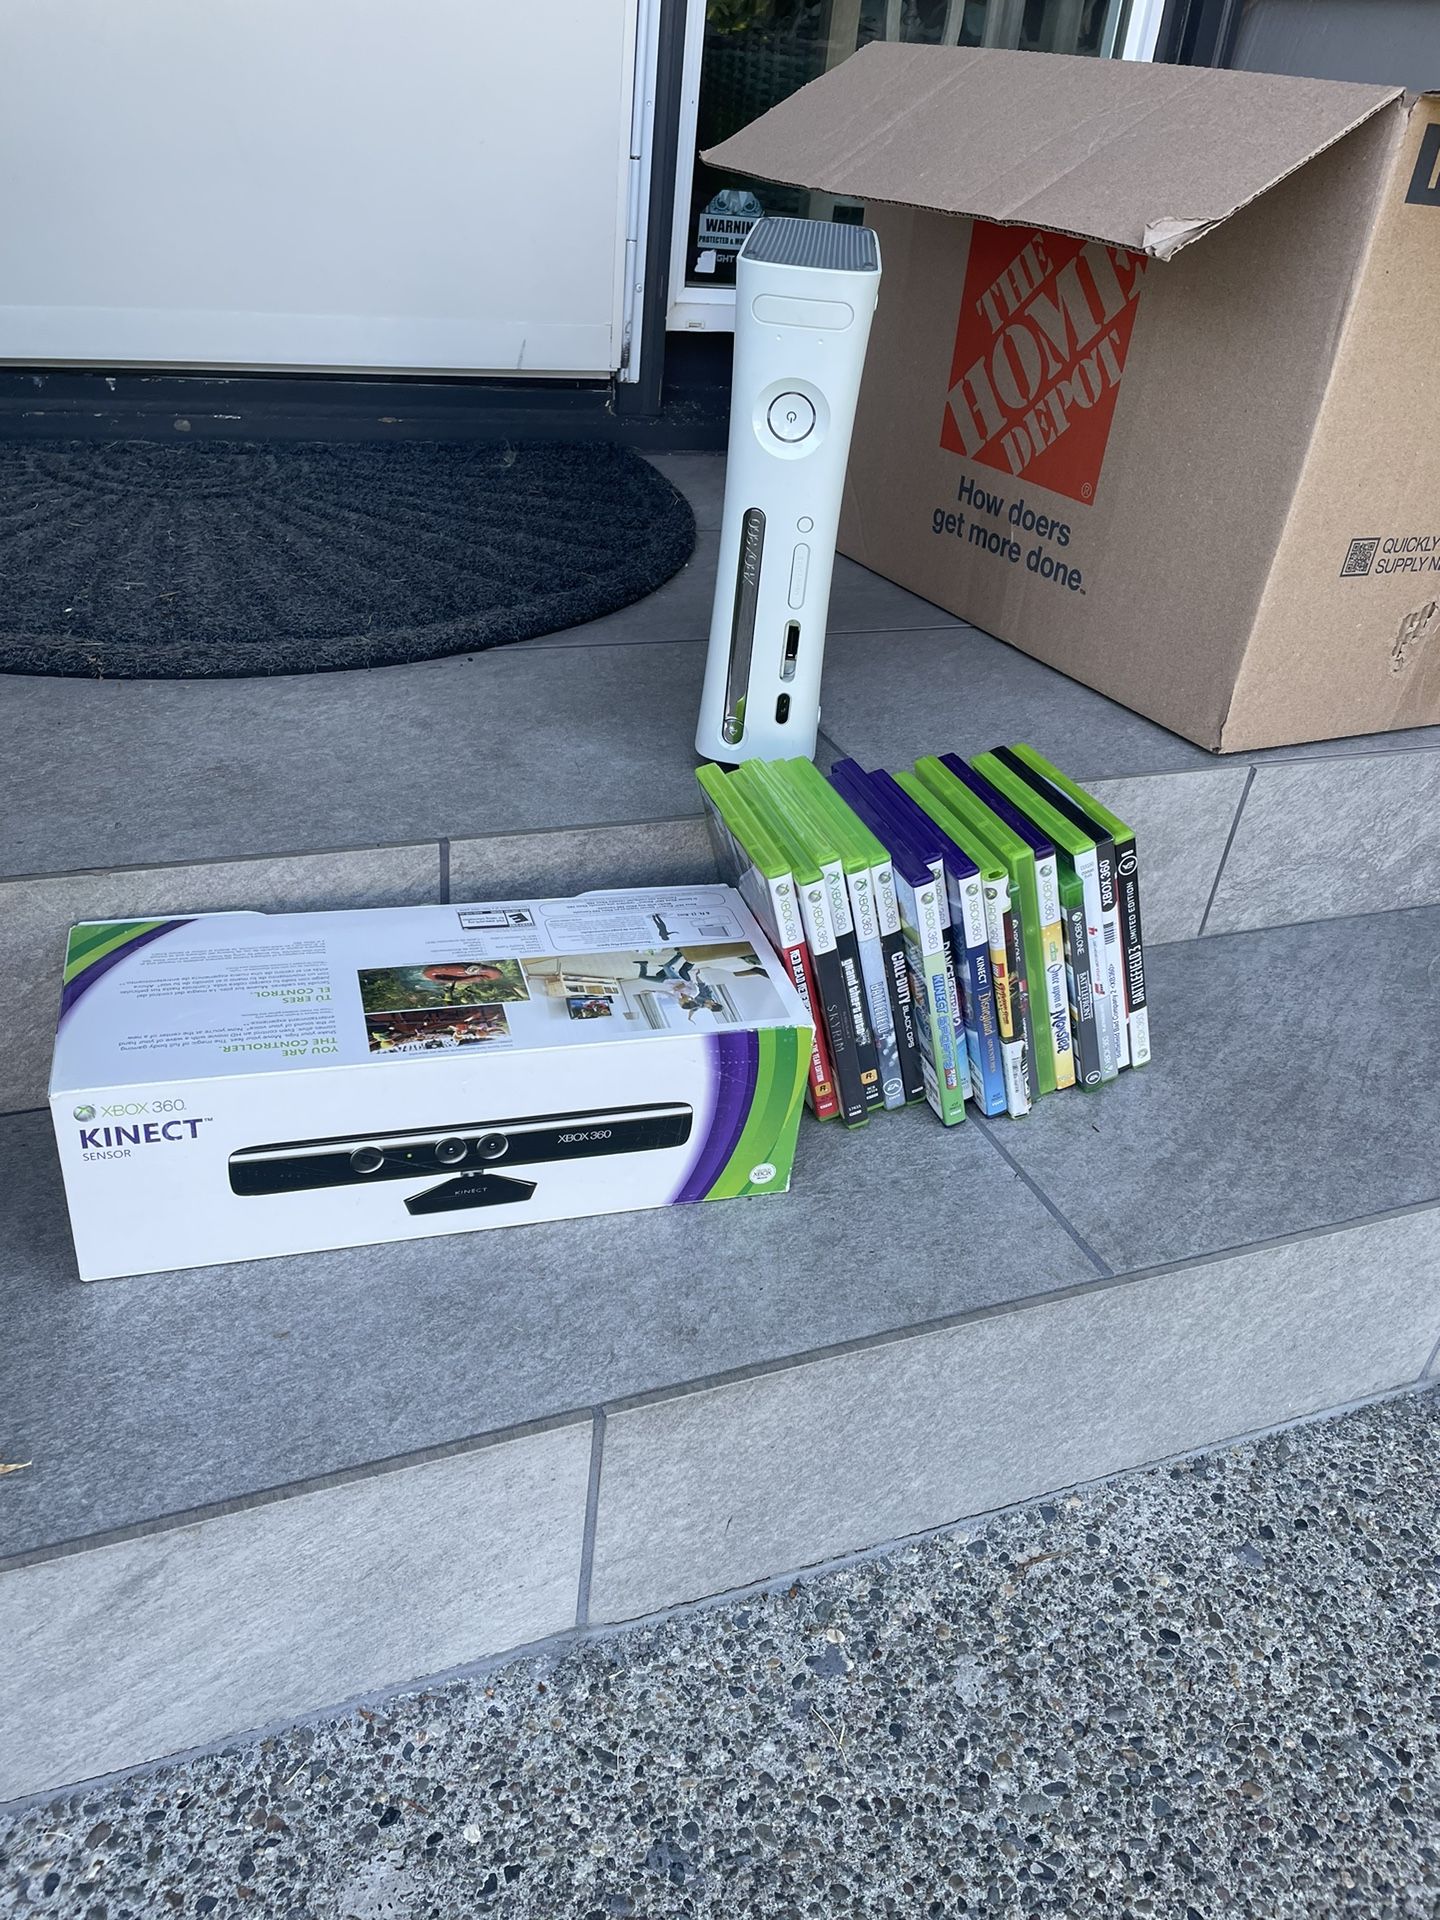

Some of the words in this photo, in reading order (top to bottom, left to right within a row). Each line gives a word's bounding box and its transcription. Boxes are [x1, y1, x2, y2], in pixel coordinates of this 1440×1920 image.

[706, 218, 754, 235] WARNIN
[976, 232, 1054, 334] THE
[947, 241, 1149, 459] HOME
[1000, 329, 1124, 476] DEPOT
[958, 475, 1002, 517] How
[1009, 498, 1071, 547] doers
[932, 505, 963, 538] get
[969, 523, 1021, 563] more
[1382, 536, 1440, 554] QUICKLY
[1375, 556, 1429, 574] SUPPLY
[1100, 860, 1110, 878] 360
[832, 885, 844, 912] XBOX
[882, 886, 894, 911] XBOX
[1043, 879, 1052, 902] XBOX
[1101, 878, 1112, 906] XBOX
[1126, 882, 1135, 913] EDITION
[780, 897, 792, 923] XBOX
[859, 892, 870, 917] XBOX
[970, 898, 980, 924] XBOX
[1044, 902, 1054, 920] 360
[813, 905, 824, 930] XBOX
[836, 912, 846, 930] 360
[862, 917, 873, 936] 360
[887, 911, 897, 929] 360
[924, 907, 936, 931] XBOX
[1074, 921, 1082, 939] XBOX
[1129, 914, 1138, 944] LIMITED
[785, 923, 797, 942] 360
[818, 930, 829, 948] 360
[928, 931, 938, 950] 360
[1075, 939, 1084, 955] ONE
[1128, 944, 1141, 954] 3
[792, 964, 806, 984] DEAD
[892, 951, 906, 978] CALL
[976, 956, 986, 984] KINECT
[896, 977, 911, 1004] DUTY
[1130, 954, 1145, 1005] BATTLEFIELD
[849, 985, 863, 1012] theft
[932, 974, 948, 1013] KINECT
[1078, 971, 1091, 1020] BATTLEFRONT
[902, 1005, 912, 1031] BLACK
[978, 991, 993, 1035] Disneyland
[1110, 994, 1120, 1020] Company
[828, 1004, 844, 1052] SKYRIM
[906, 1031, 915, 1048] OPS
[312, 1046, 337, 1054] YOU
[937, 1016, 955, 1069] SPORTS
[101, 1103, 150, 1117] XBOX
[558, 1132, 589, 1144] XBOX
[590, 1130, 612, 1140] 360
[82, 1150, 131, 1161] SENSOR
[454, 1187, 488, 1196] KINECT
